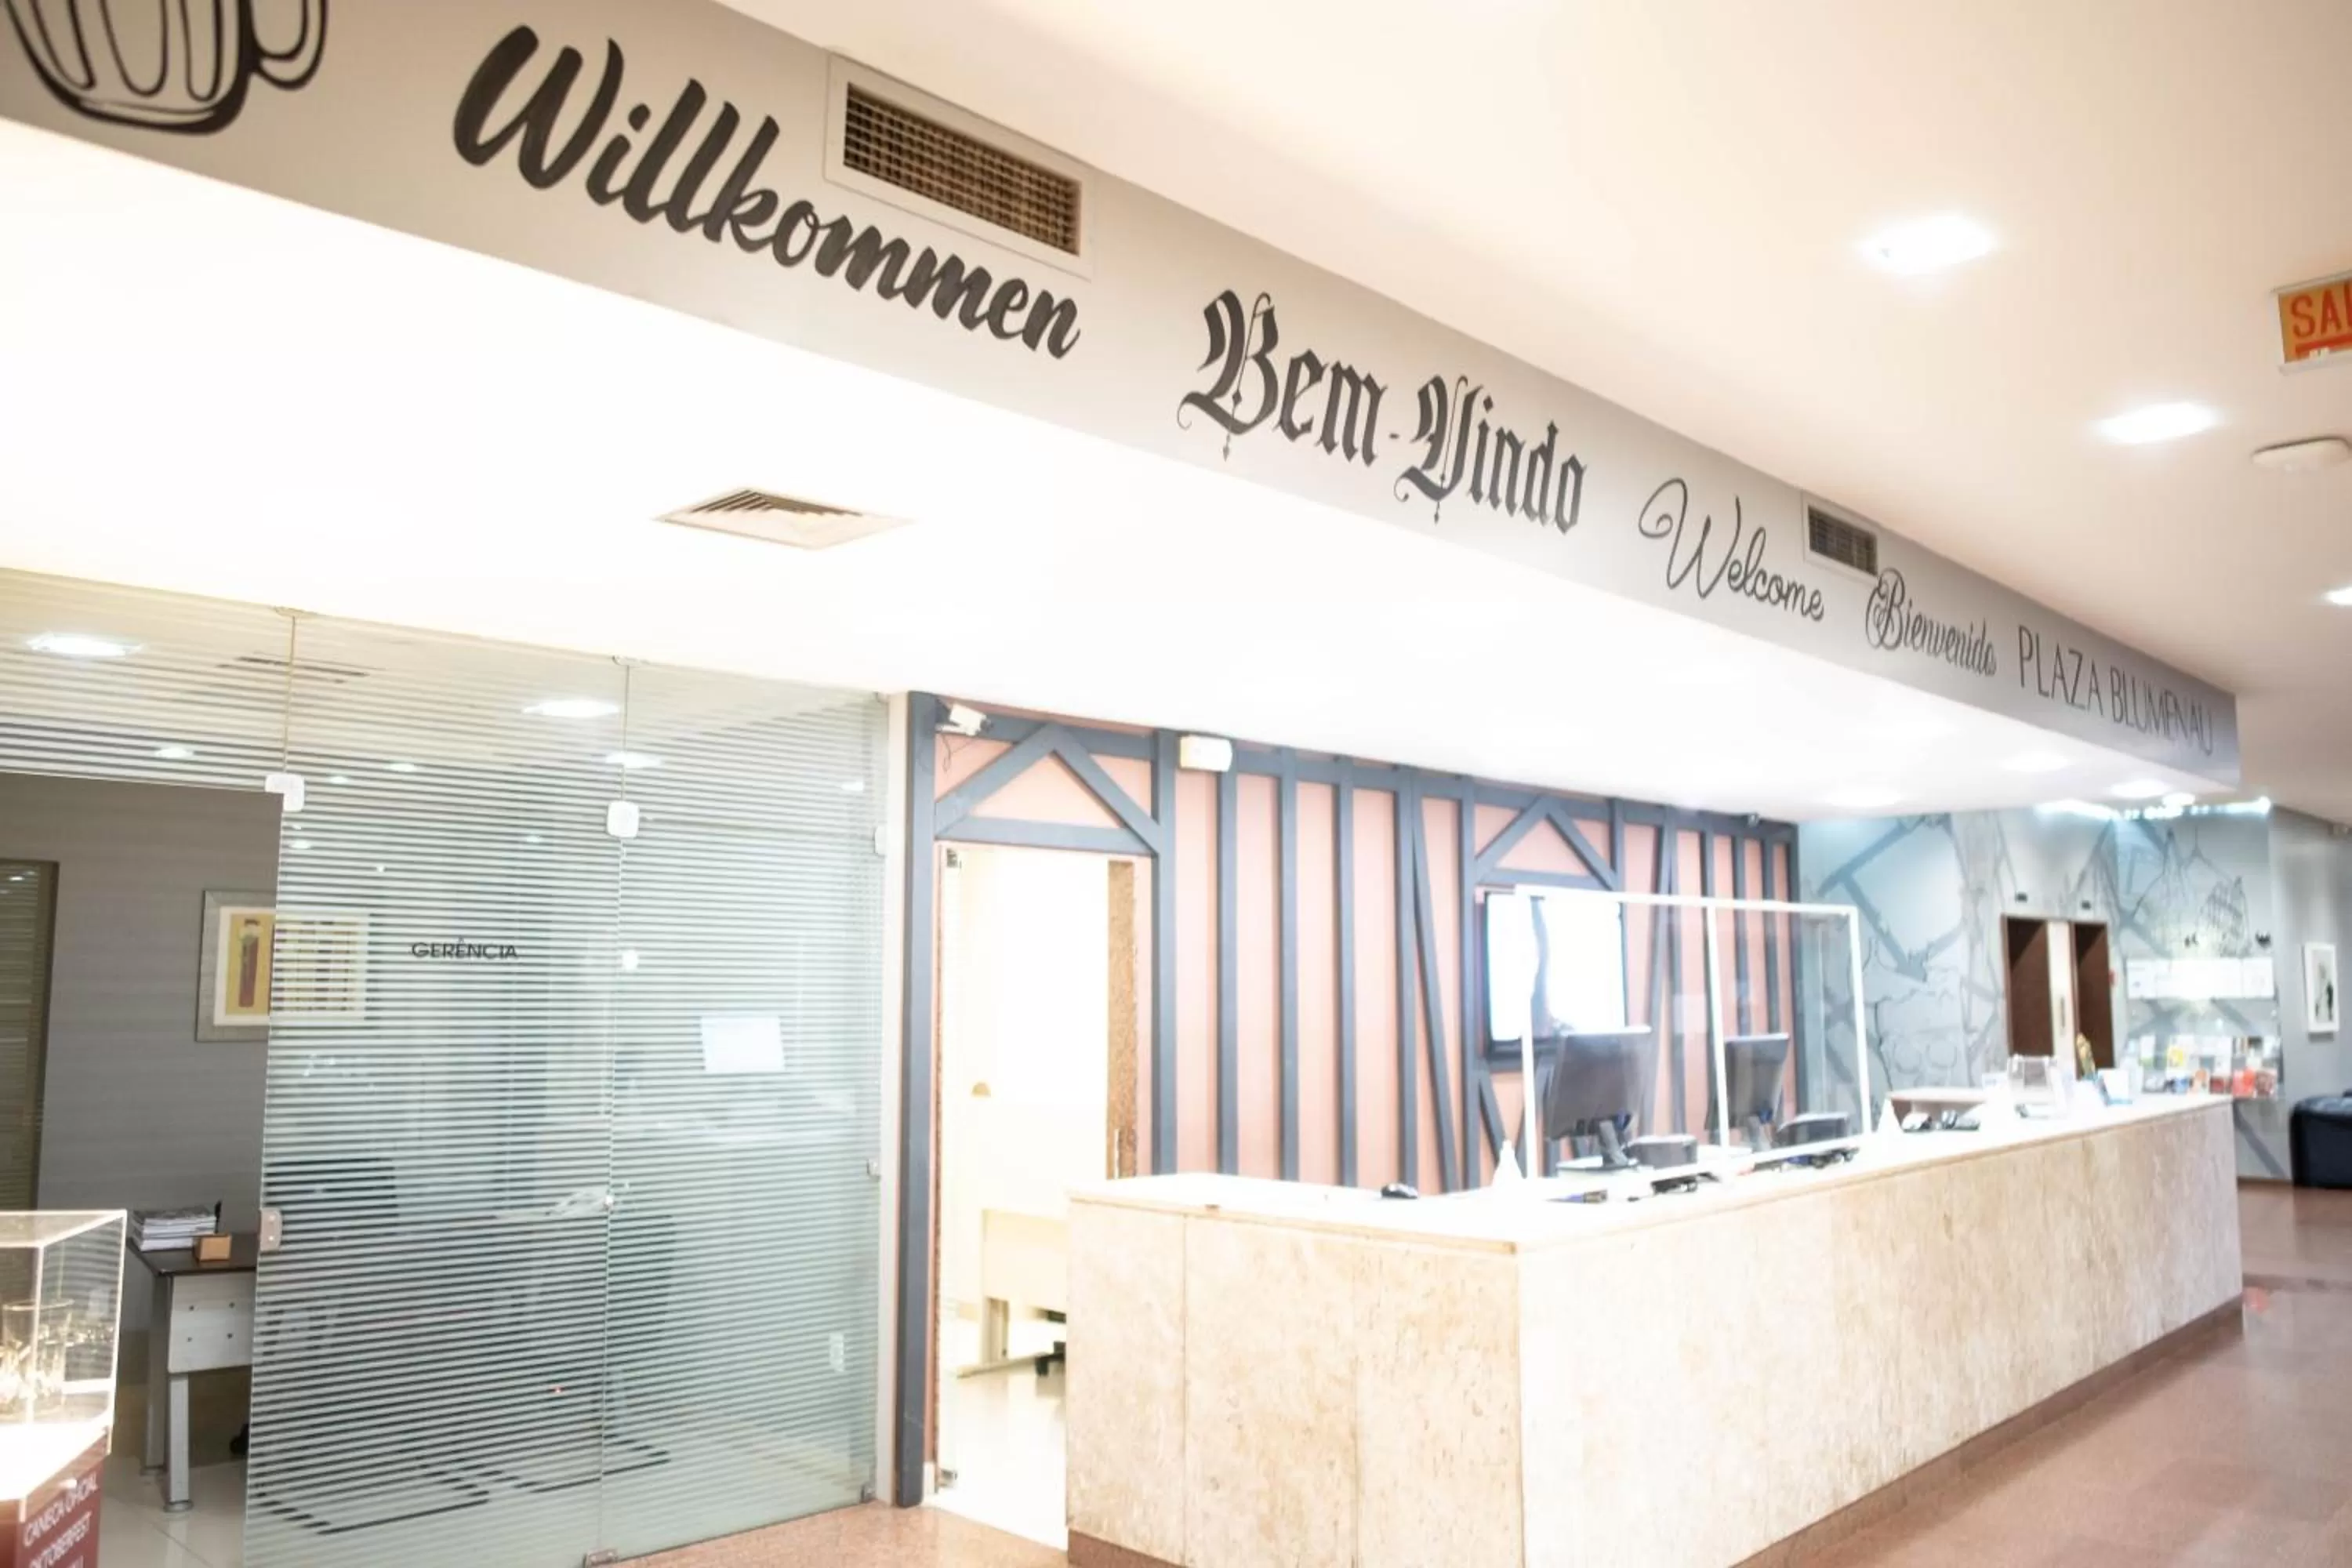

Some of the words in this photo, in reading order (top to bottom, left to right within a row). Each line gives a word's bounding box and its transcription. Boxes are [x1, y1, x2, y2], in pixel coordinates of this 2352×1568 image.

[452, 24, 1080, 360] Willkommen
[1638, 477, 1825, 621] Welcome
[1865, 567, 1997, 677] Bienvenido
[2017, 624, 2105, 718] PLAZA
[2109, 664, 2214, 757] BLUMENAU
[412, 935, 518, 959] GERÊNCIA
